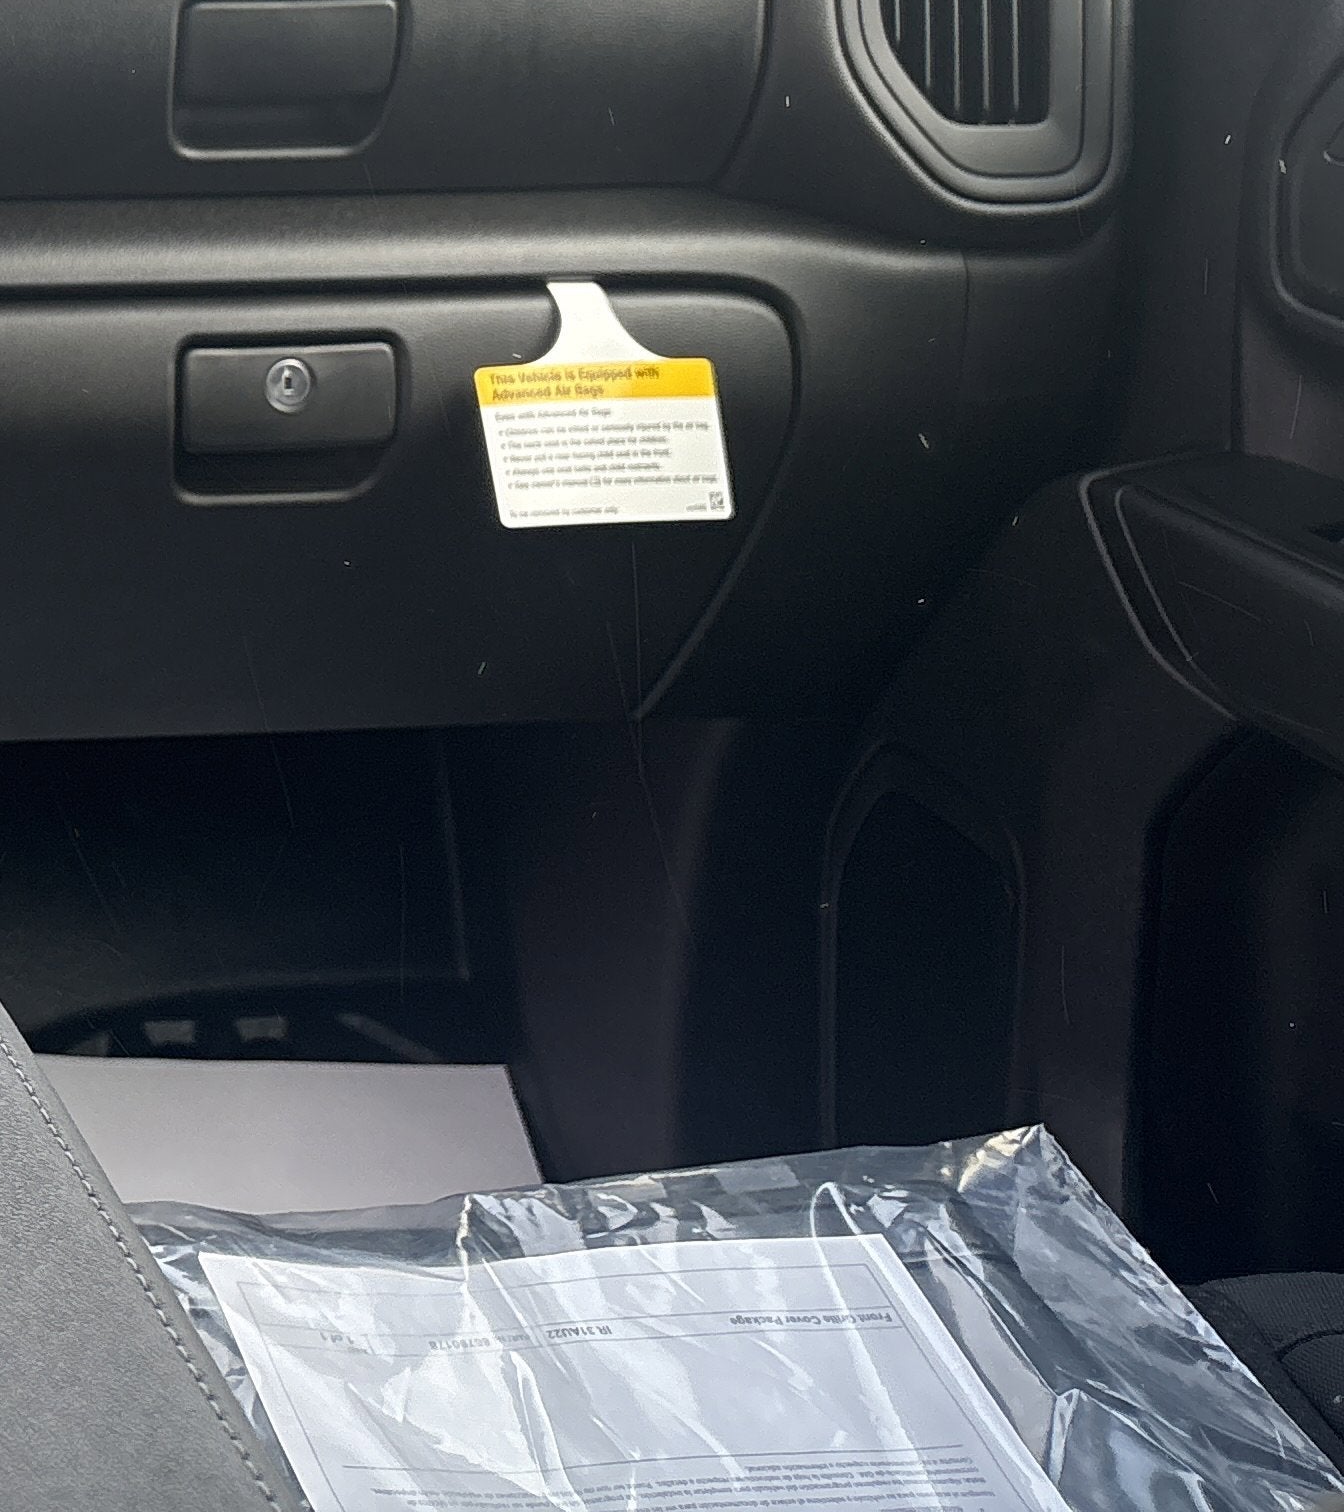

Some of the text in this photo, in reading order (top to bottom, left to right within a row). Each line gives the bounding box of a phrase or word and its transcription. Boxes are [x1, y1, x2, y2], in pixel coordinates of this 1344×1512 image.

[490, 373, 515, 385] This
[517, 369, 562, 383] Vehicle
[578, 366, 633, 382] Equipped
[635, 366, 660, 379] with
[492, 386, 552, 401] Advanced
[554, 385, 572, 396] Air
[729, 1315, 784, 1327] Package
[785, 1315, 822, 1326] Cover
[858, 1312, 893, 1324] Front
